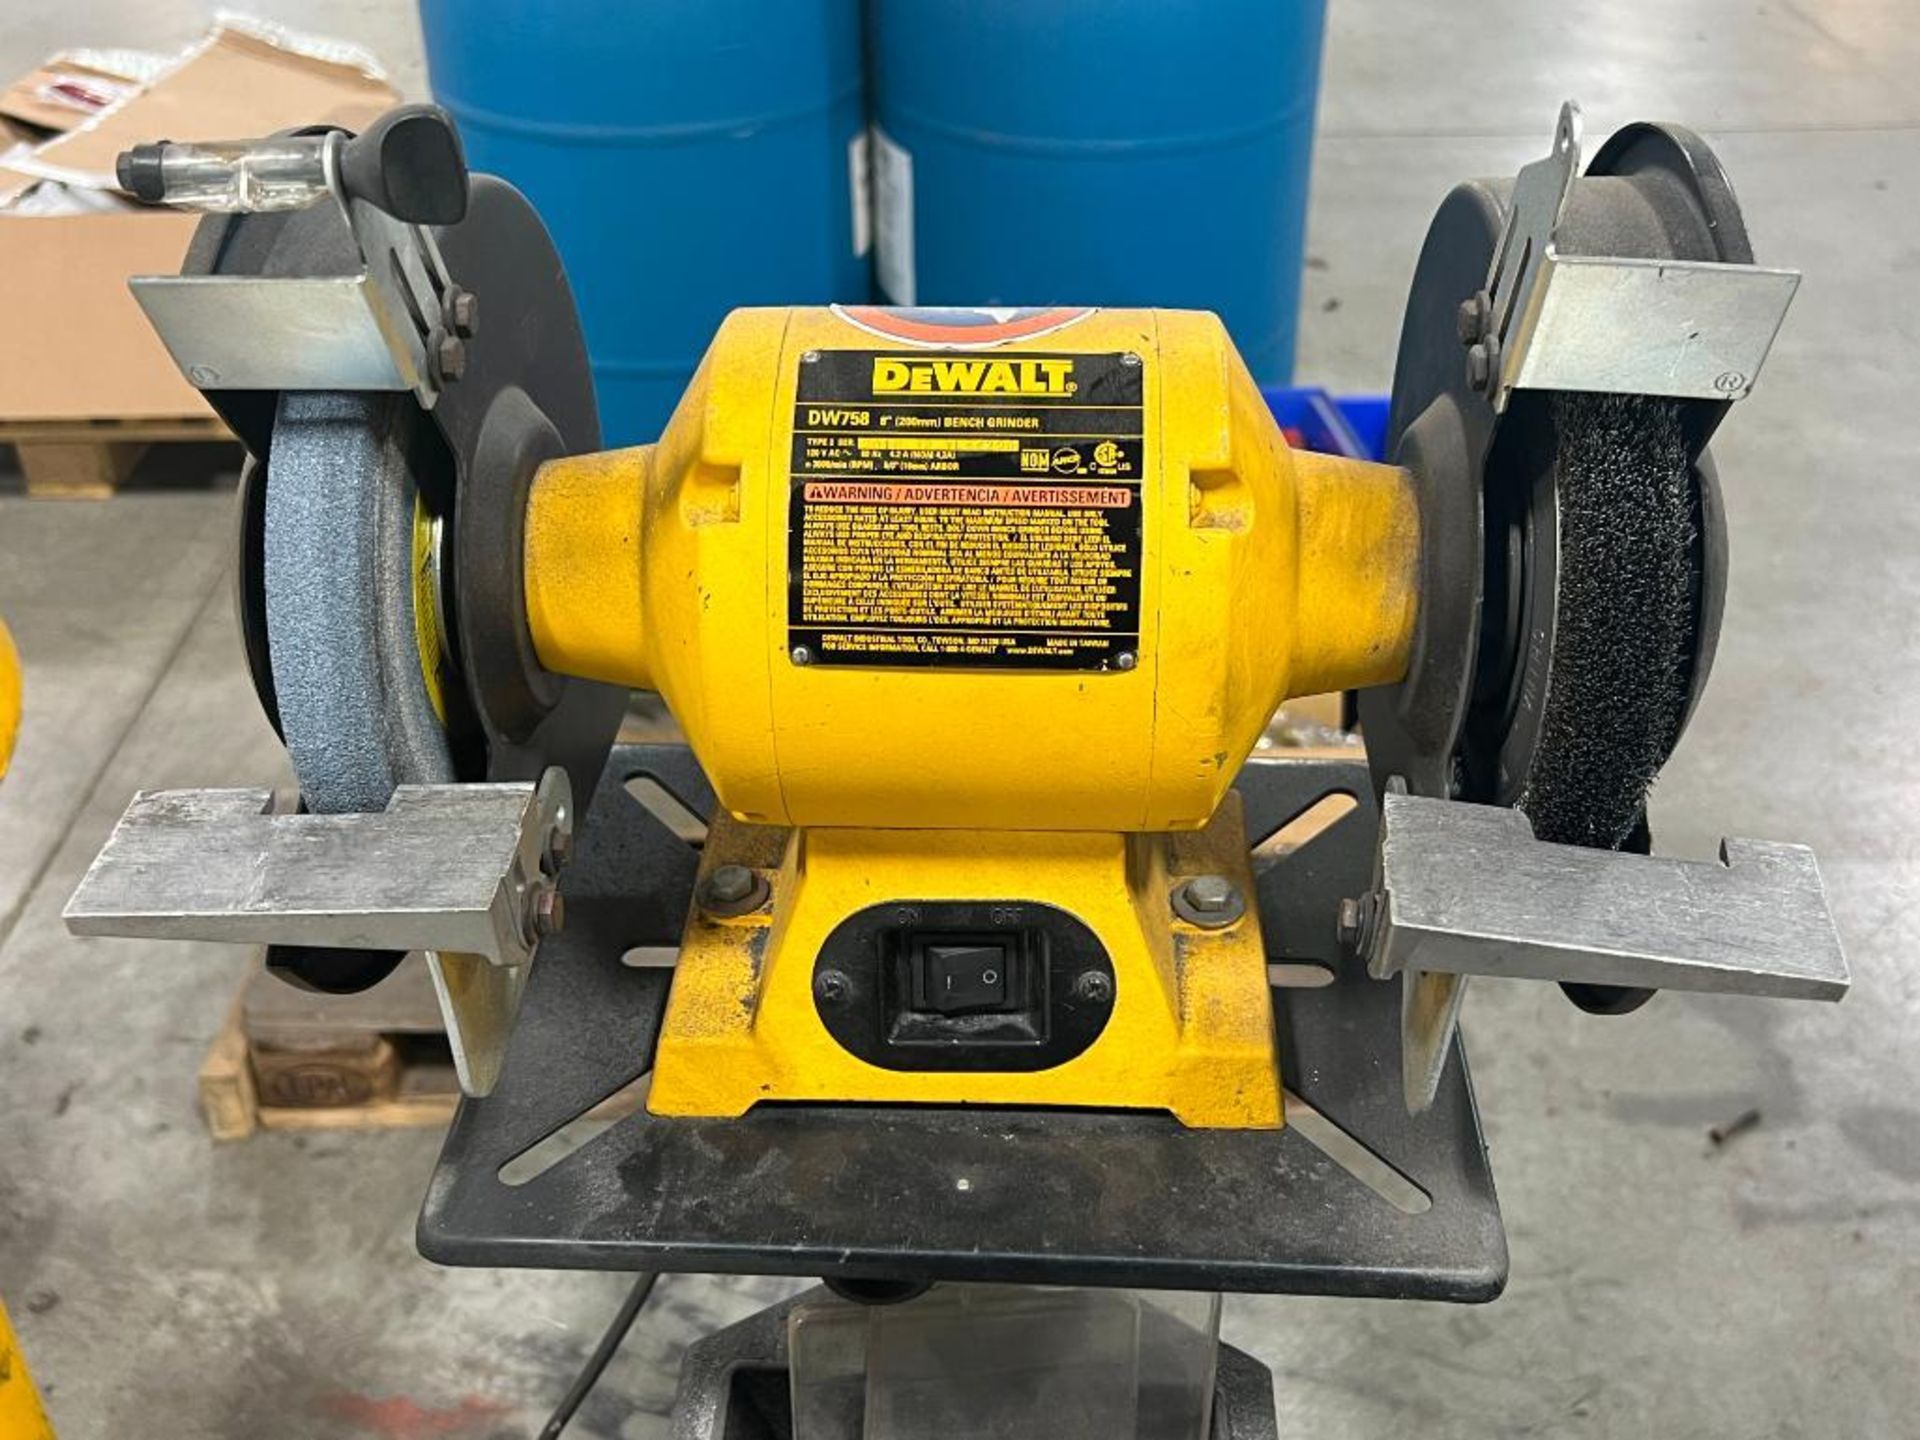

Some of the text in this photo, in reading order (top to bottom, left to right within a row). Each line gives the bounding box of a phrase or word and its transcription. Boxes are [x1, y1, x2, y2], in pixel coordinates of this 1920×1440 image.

[808, 410, 870, 426] DW758
[944, 417, 983, 428] BENCH
[987, 417, 1039, 428] GRINDER
[824, 487, 892, 500] WARNING
[904, 488, 999, 503] ADVERTENCIA
[1012, 489, 1126, 504] AVERTISSEMENT
